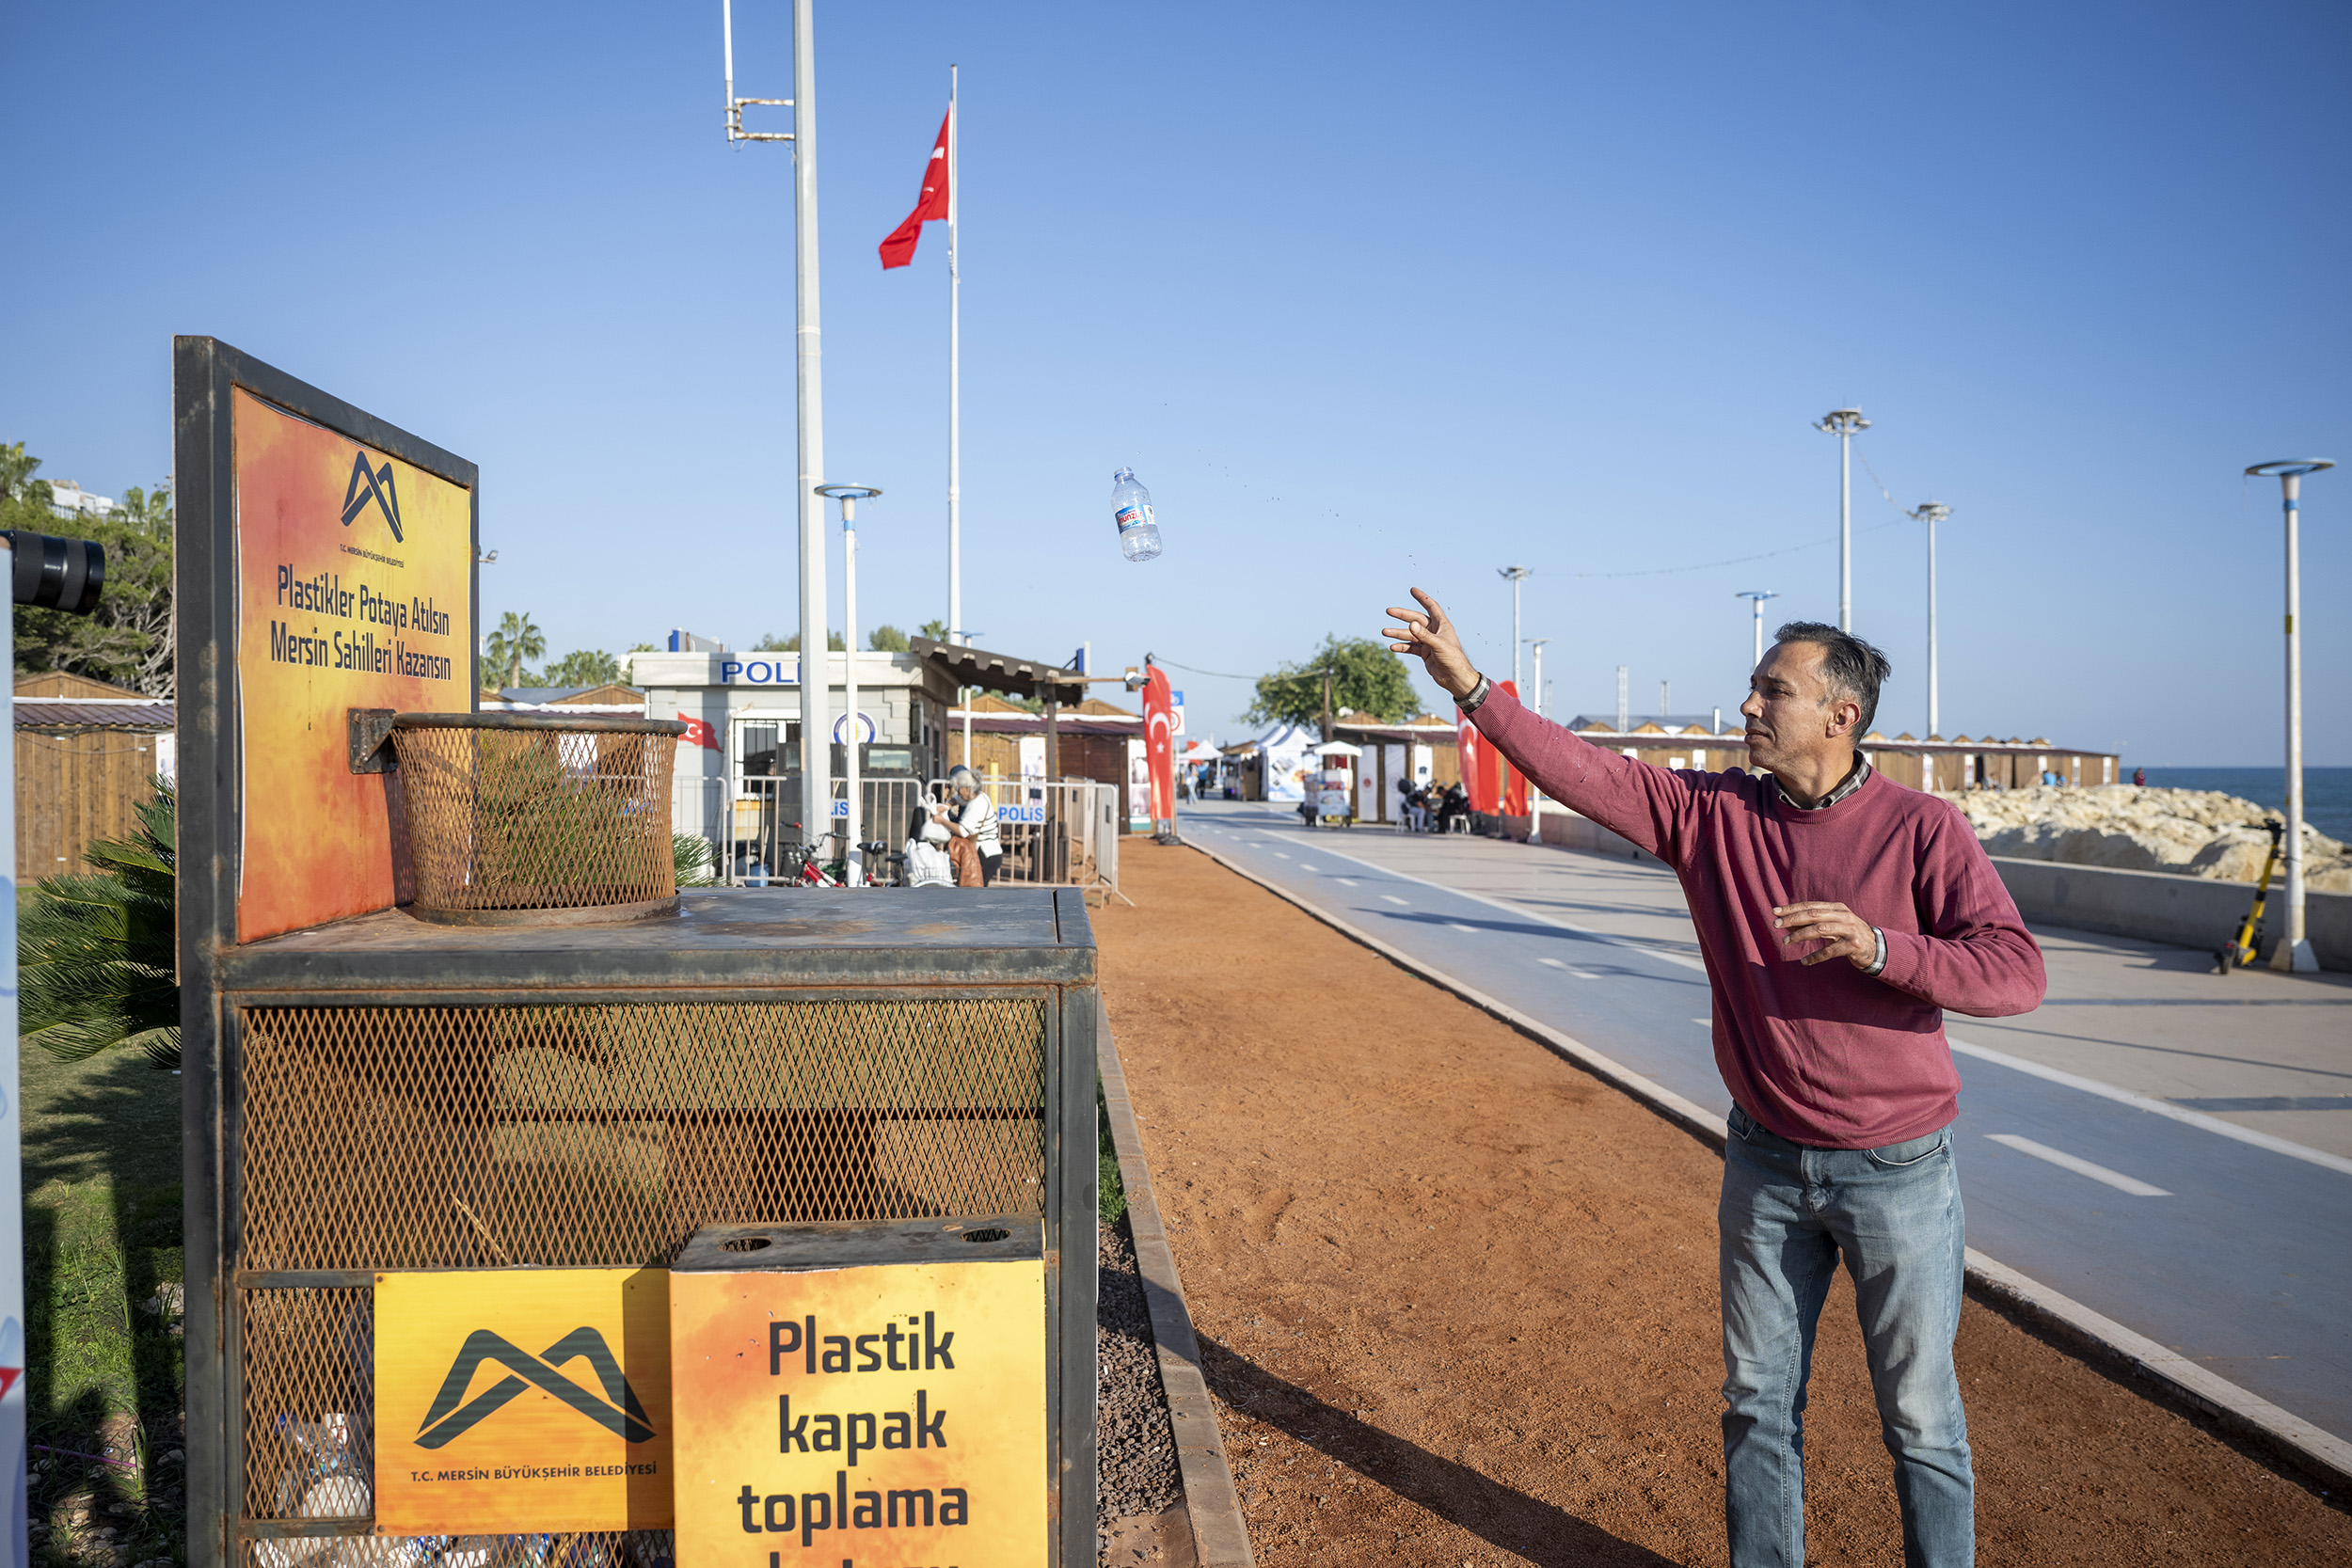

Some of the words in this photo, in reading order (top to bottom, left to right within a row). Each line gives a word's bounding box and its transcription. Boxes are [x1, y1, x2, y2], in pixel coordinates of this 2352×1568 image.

[278, 563, 355, 618] Plastikler
[359, 583, 407, 637] Potaya
[411, 596, 450, 637] Atılsın
[270, 620, 328, 667] Mersin
[334, 629, 392, 674] Sahilleri
[396, 640, 452, 680] Kazansın
[722, 656, 801, 683] POLİ
[770, 1311, 955, 1375] Plastik
[779, 1389, 947, 1466] kapak
[411, 1471, 434, 1482] T.C.
[437, 1466, 489, 1481] MERSİN
[494, 1464, 580, 1481] BÜYÜKŞEHİR
[585, 1461, 657, 1477] BELEDİYESİ
[738, 1470, 968, 1547] toplama
